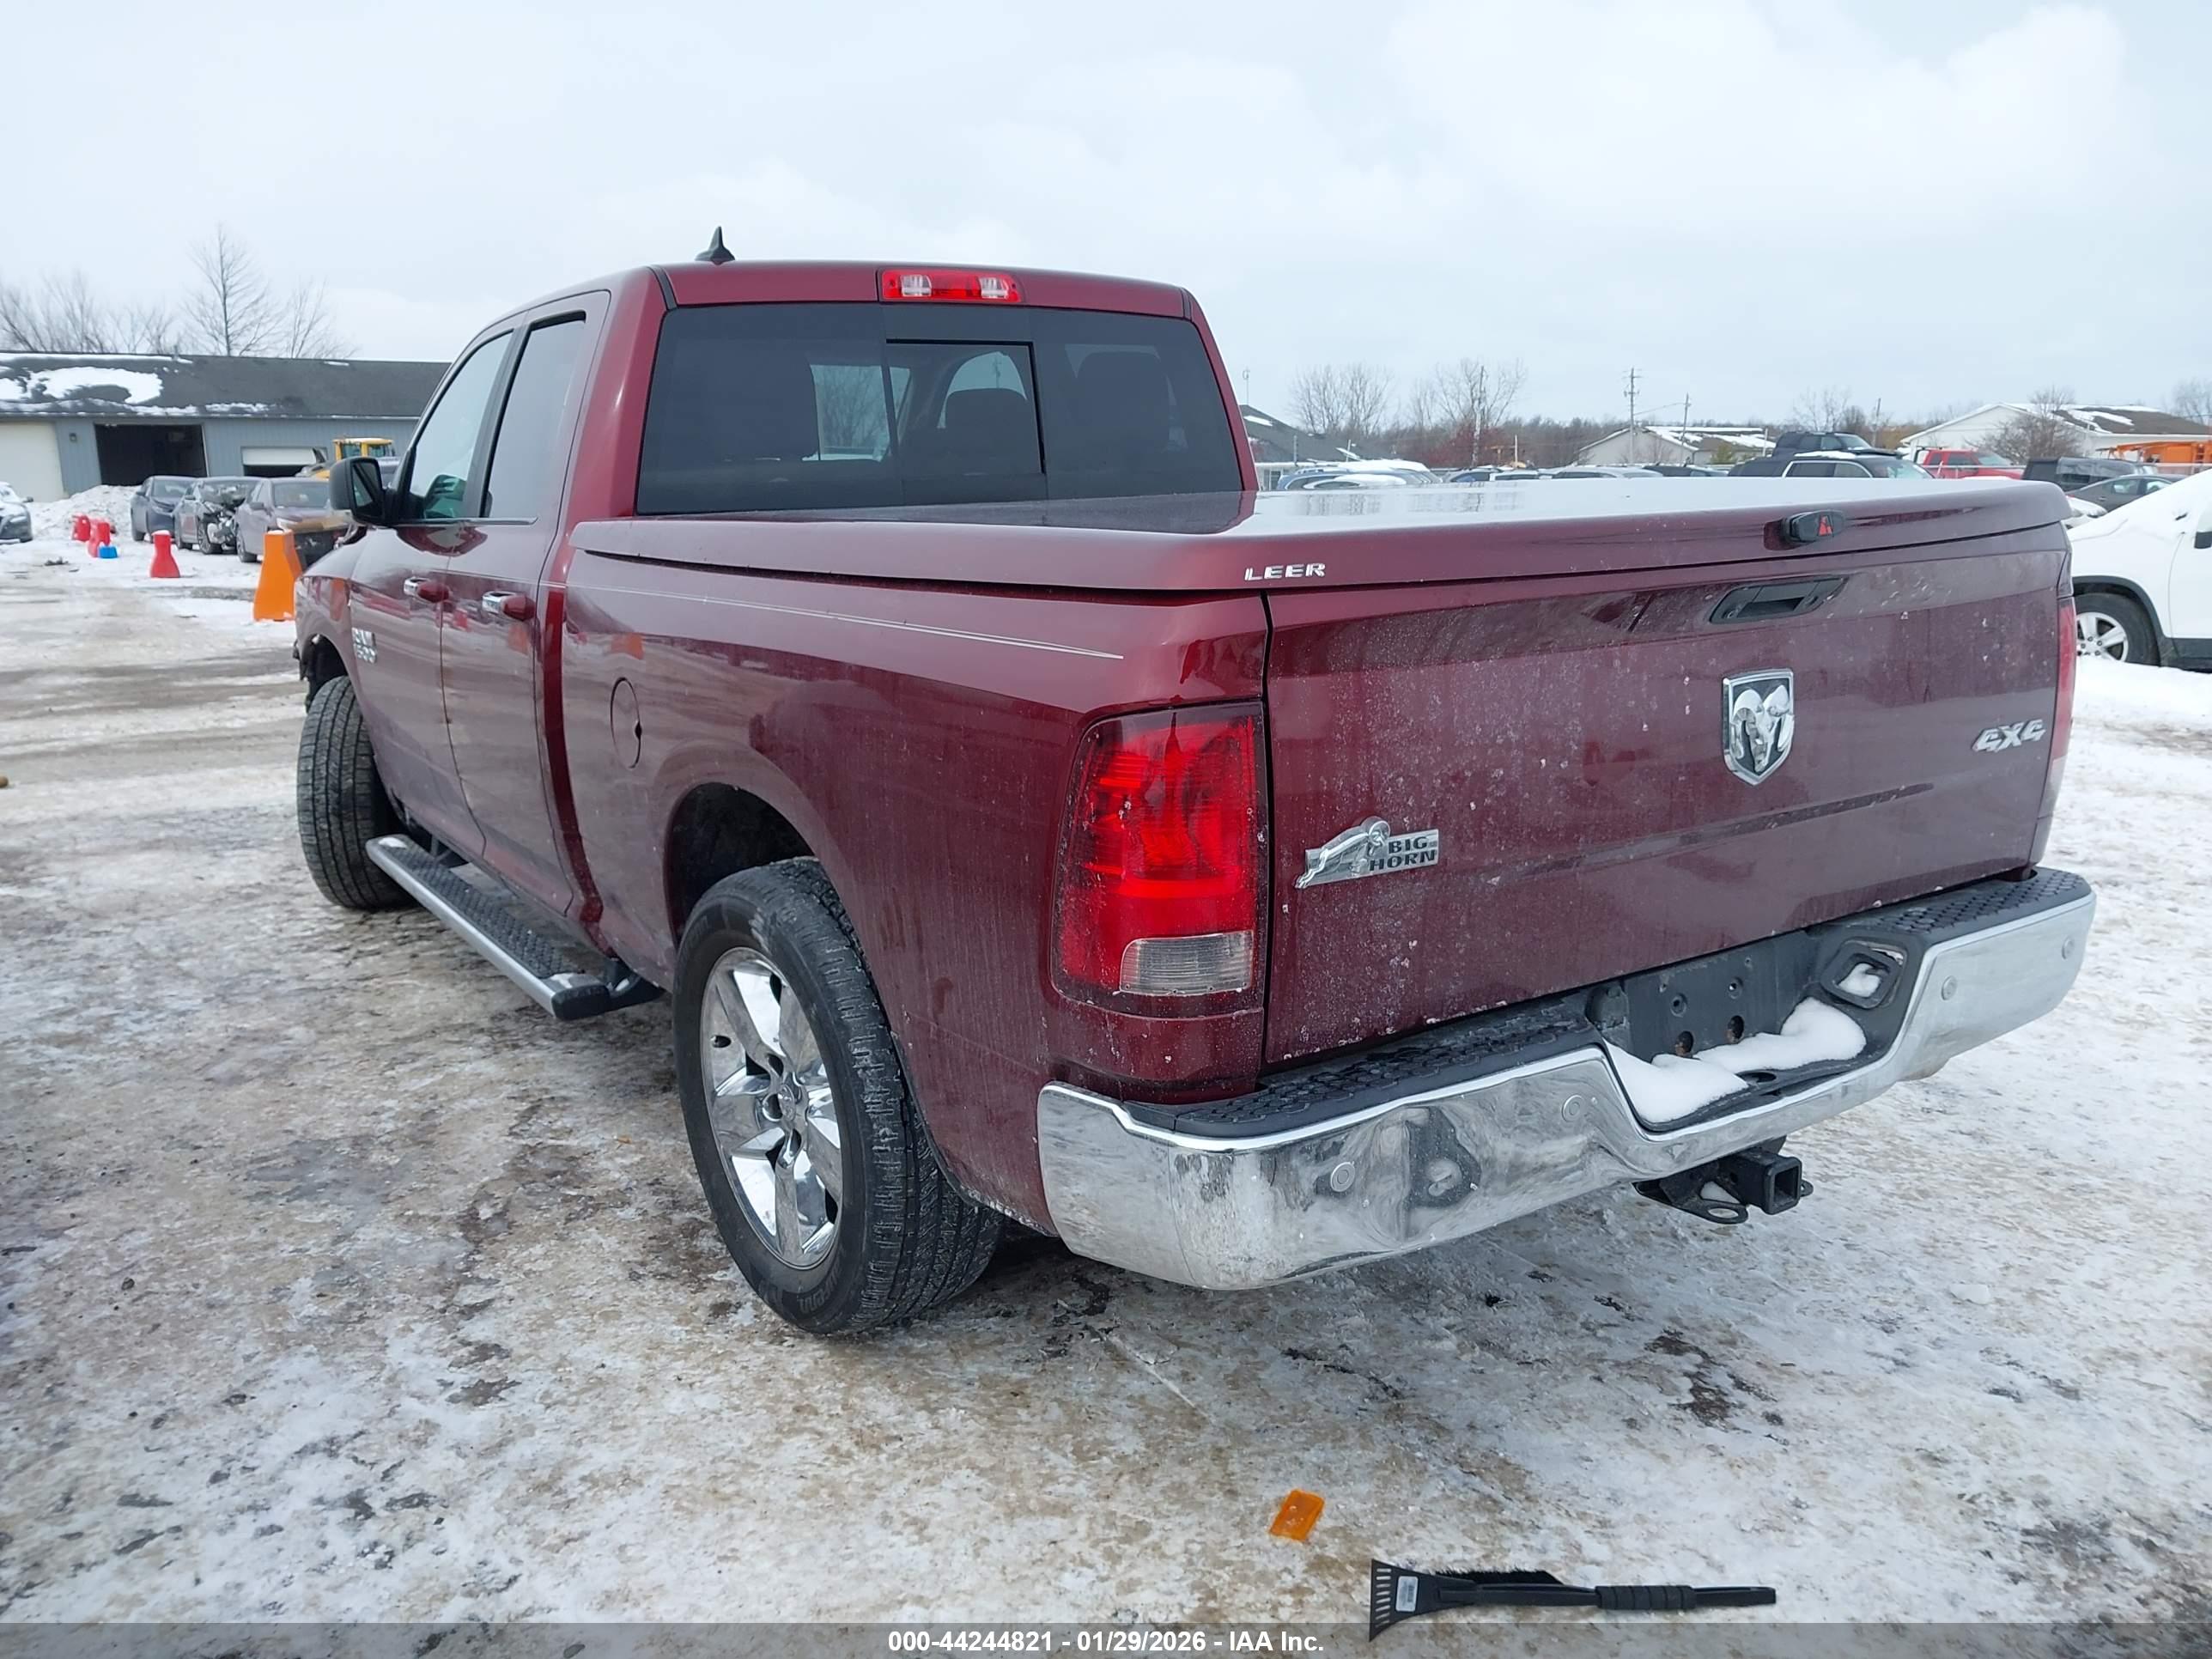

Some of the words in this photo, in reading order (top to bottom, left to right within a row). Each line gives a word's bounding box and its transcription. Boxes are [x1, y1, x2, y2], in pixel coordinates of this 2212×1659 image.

[1244, 563, 1326, 580] LEER
[1388, 836, 1429, 854] BIG
[1369, 849, 1437, 872] HORN
